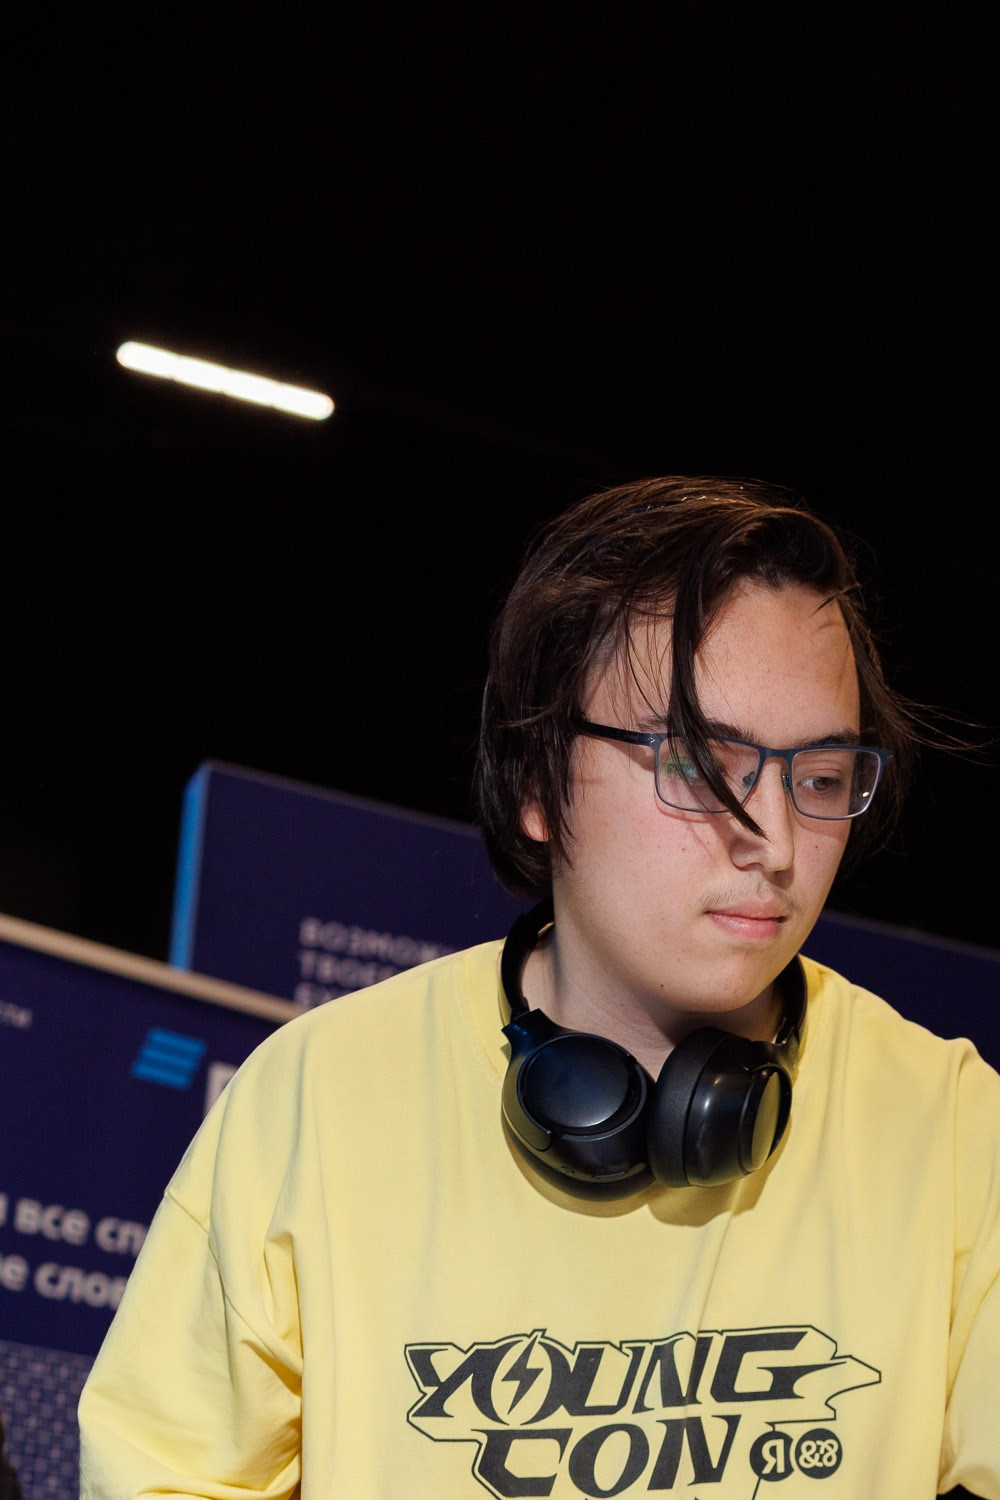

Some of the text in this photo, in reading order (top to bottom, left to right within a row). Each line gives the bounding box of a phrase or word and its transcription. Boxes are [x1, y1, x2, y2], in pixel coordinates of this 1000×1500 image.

[14, 1197, 91, 1246] все
[410, 1330, 848, 1426] YOUNG
[470, 1413, 743, 1499] CON
